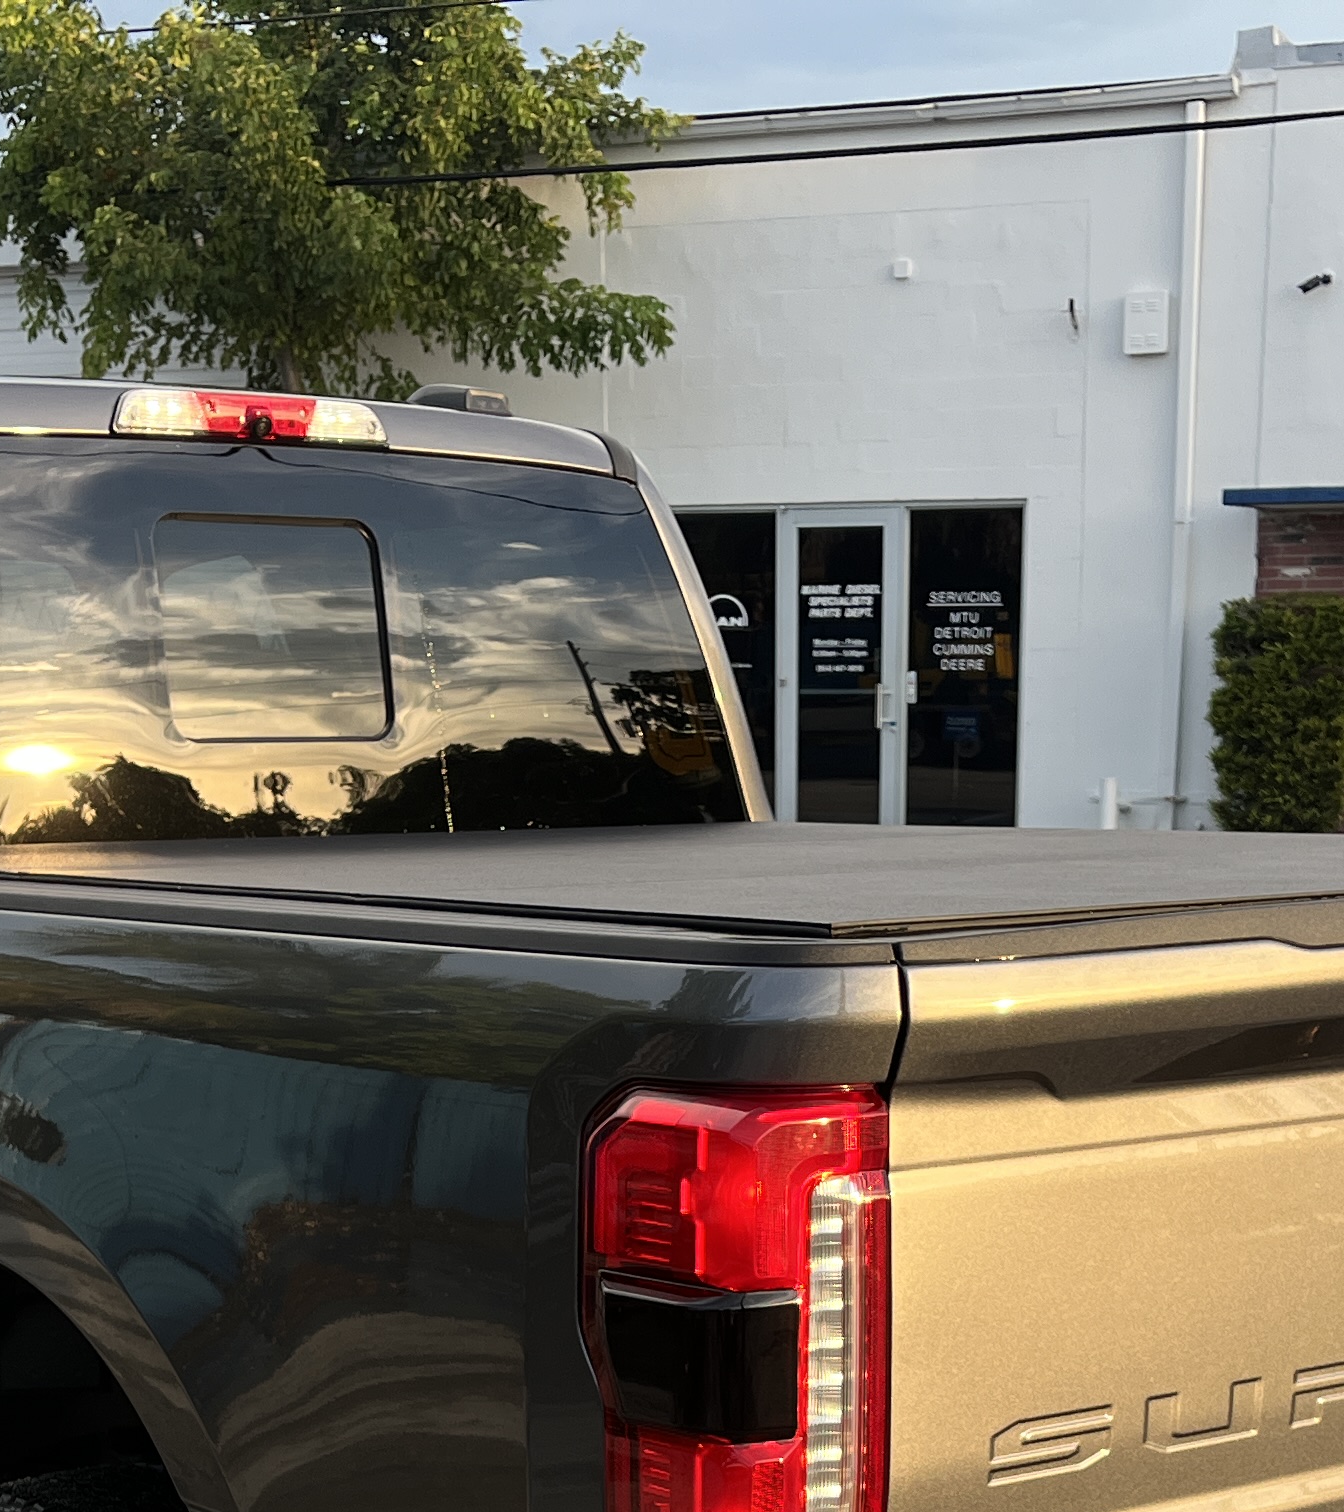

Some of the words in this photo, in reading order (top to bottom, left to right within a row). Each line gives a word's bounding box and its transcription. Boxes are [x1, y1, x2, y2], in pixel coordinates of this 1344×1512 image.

[928, 591, 1002, 603] SERVICING
[949, 611, 980, 624] MTU
[934, 627, 994, 639] DETROIT
[932, 644, 995, 656] CUMMINS
[940, 658, 985, 671] DEERE
